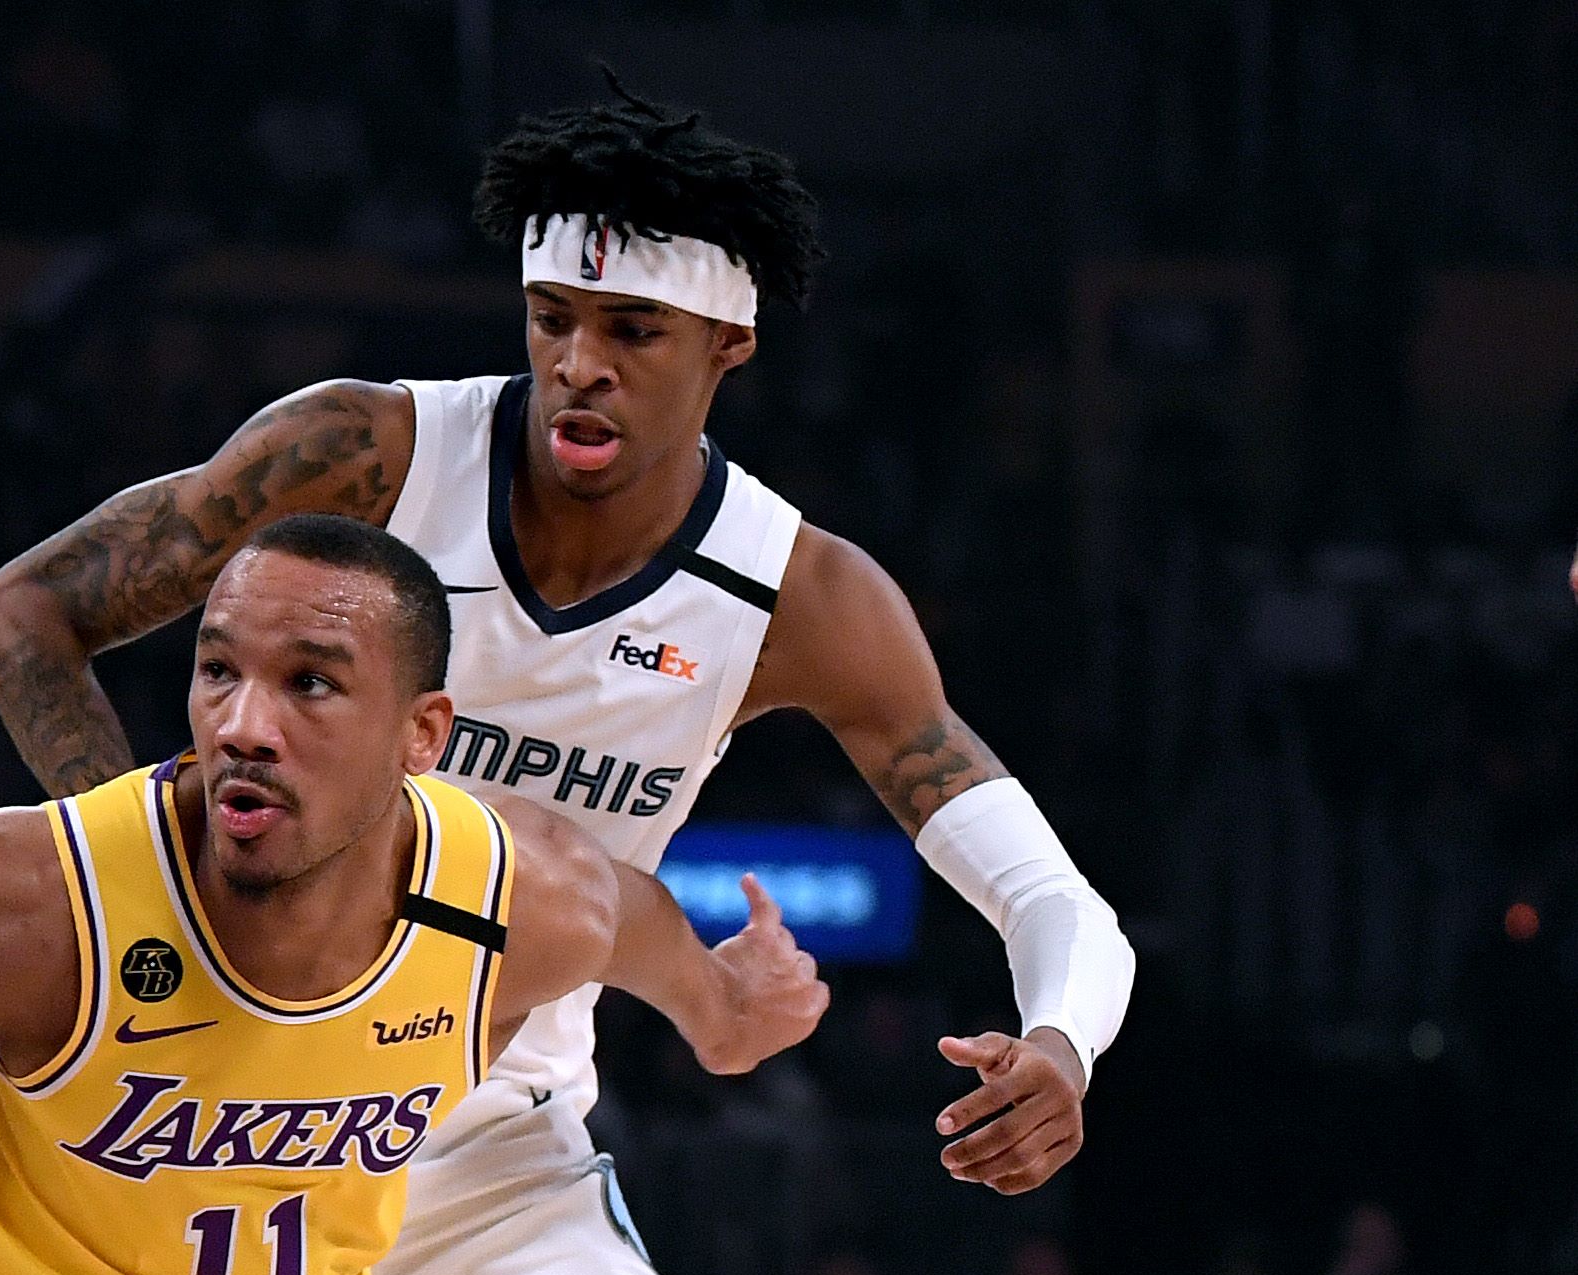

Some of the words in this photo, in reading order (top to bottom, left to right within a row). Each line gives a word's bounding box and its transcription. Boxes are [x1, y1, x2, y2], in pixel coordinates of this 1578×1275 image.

[609, 634, 699, 681] FedEx
[436, 715, 686, 816] MPHIS
[372, 1006, 454, 1045] wish
[55, 1072, 445, 1183] LAKERS
